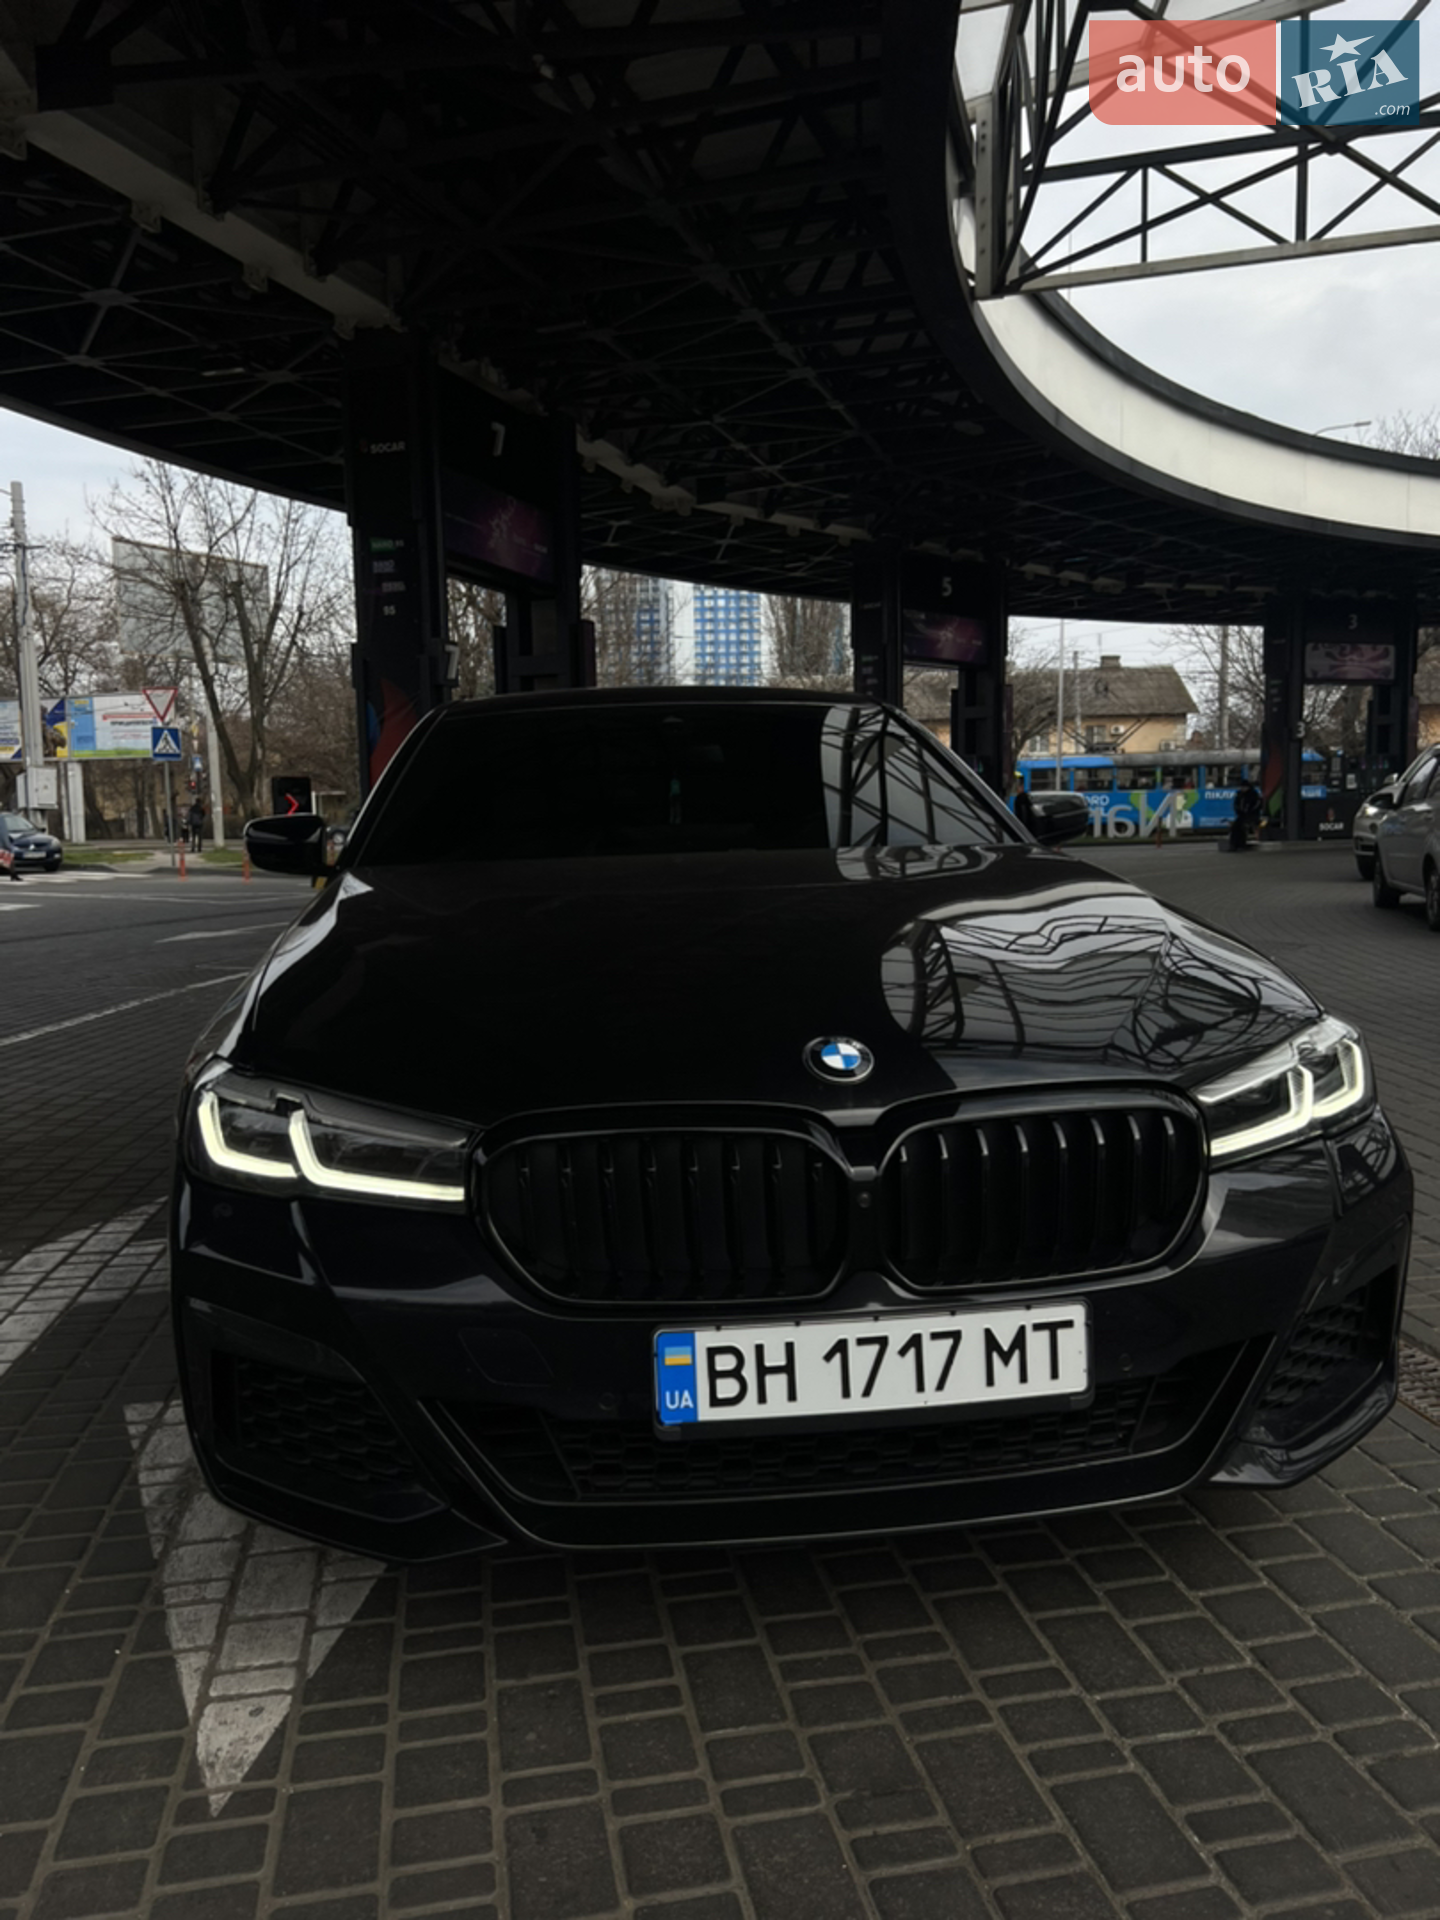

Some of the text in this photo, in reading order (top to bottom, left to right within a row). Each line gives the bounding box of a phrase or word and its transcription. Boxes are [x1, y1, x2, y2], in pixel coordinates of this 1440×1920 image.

[369, 440, 406, 455] SOCAR
[490, 420, 506, 458] 7
[941, 576, 953, 597] 5
[1348, 613, 1359, 630] 3
[443, 643, 460, 680] 7
[1296, 721, 1306, 738] 3
[1318, 820, 1345, 832] SOCAR
[706, 1319, 1075, 1408] BH 1717 MT
[665, 1390, 694, 1410] UA
